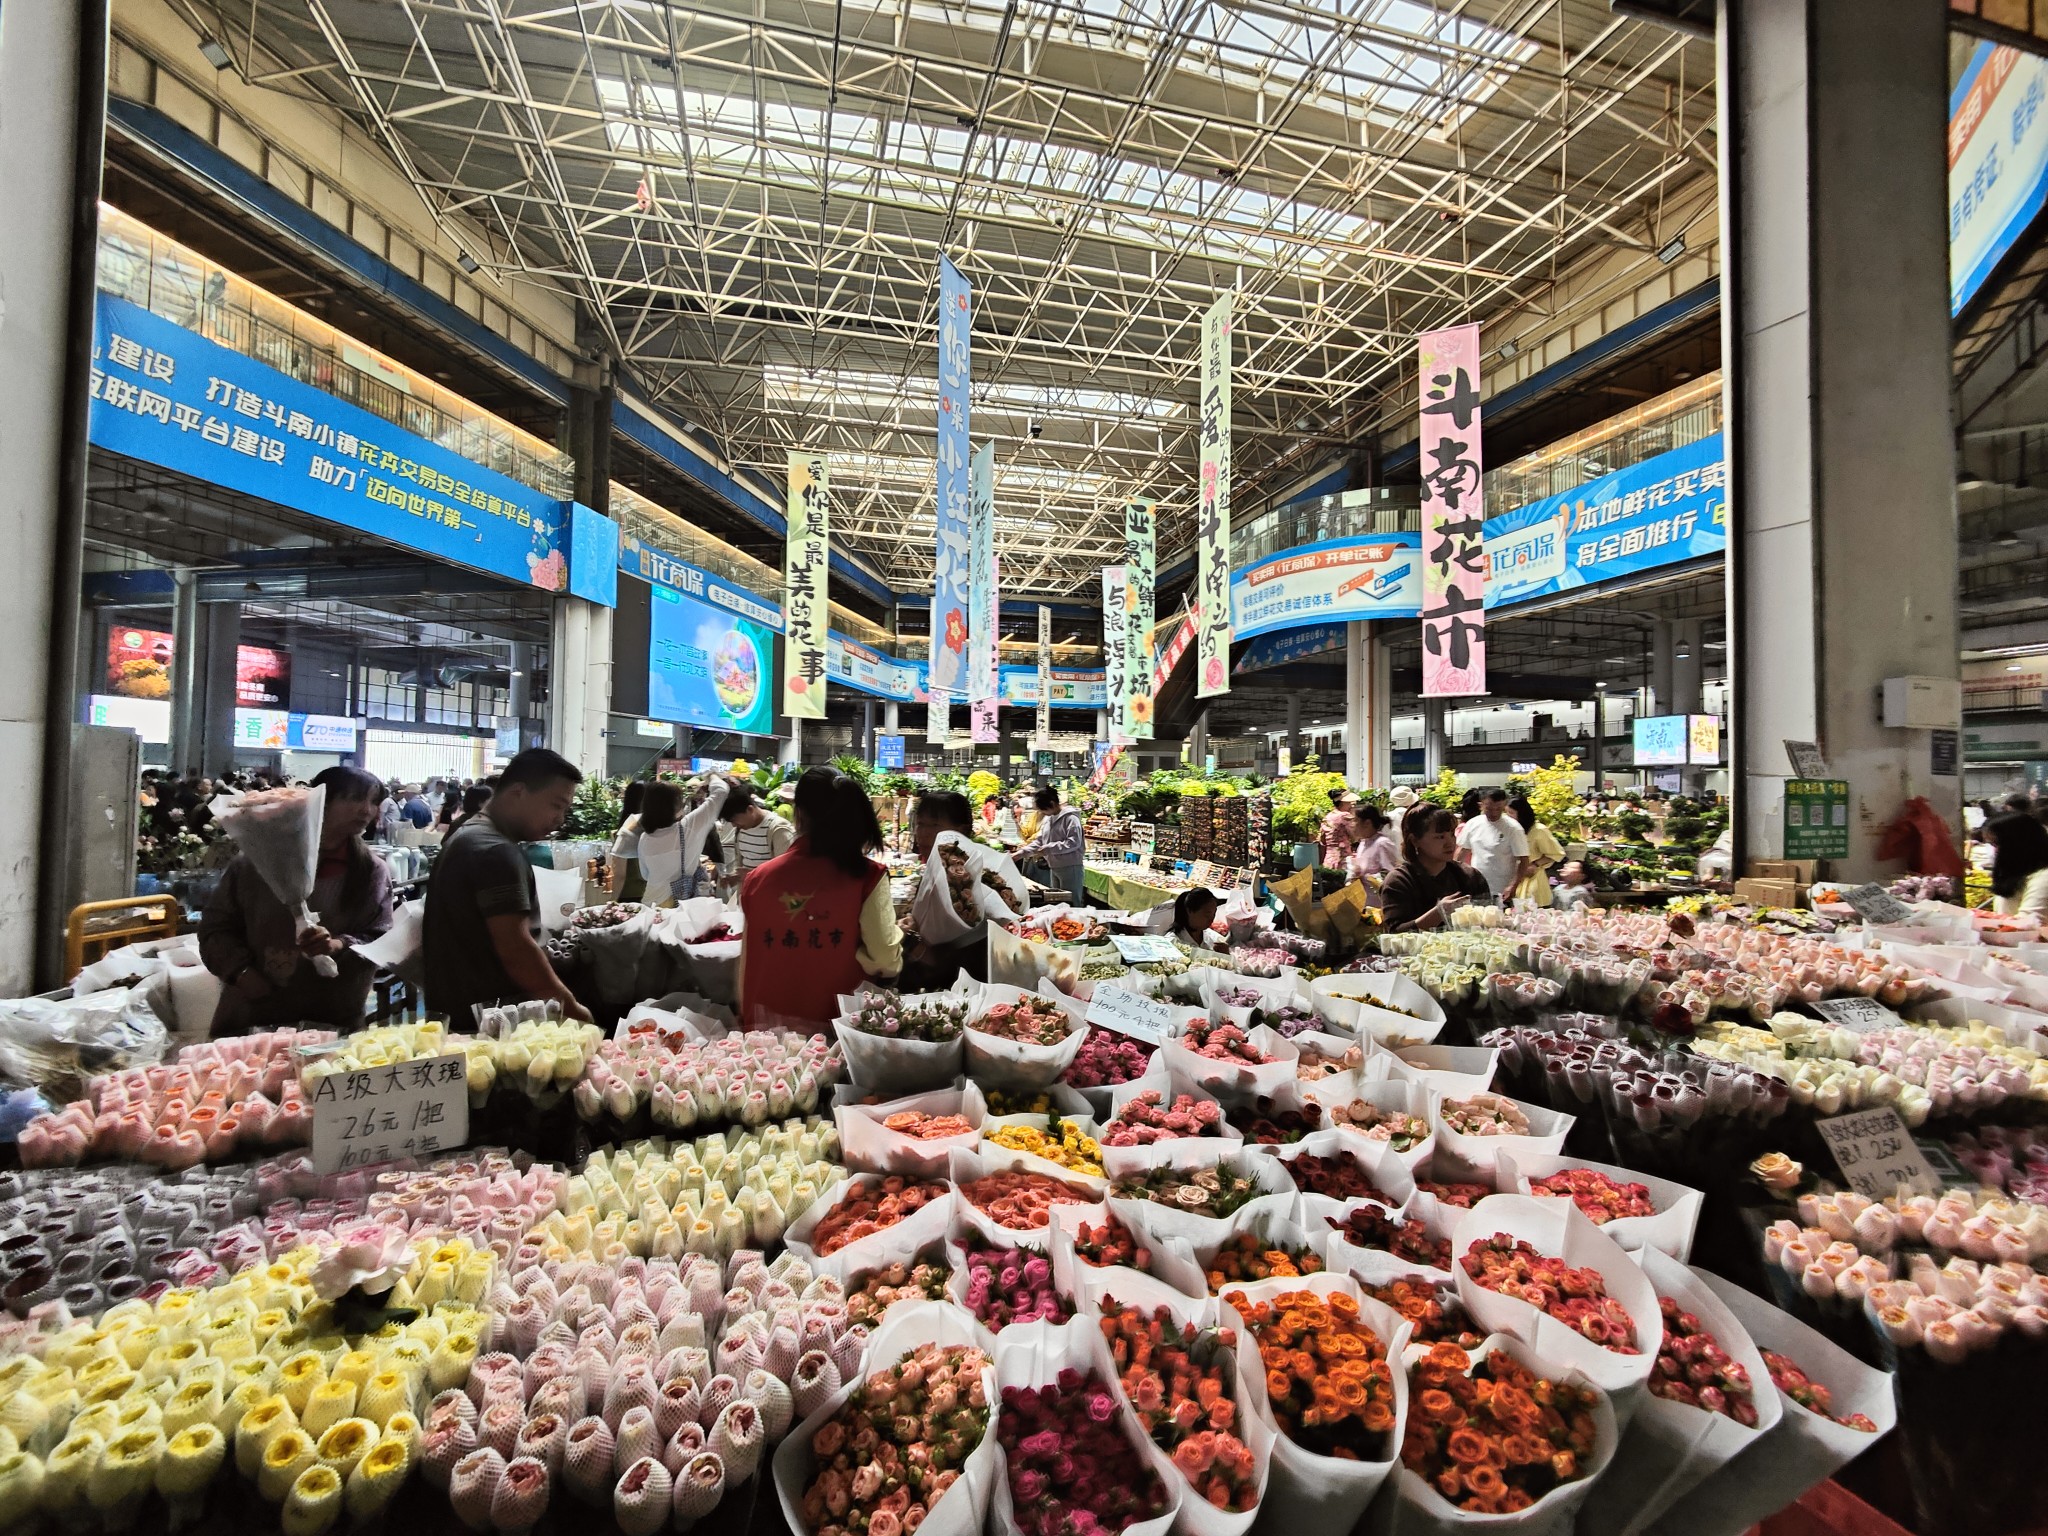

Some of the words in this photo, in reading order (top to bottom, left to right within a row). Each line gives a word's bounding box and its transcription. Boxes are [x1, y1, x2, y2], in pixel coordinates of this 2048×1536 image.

[205, 376, 532, 528] 打造斗南小镇花卉交易安全结算平台
[1199, 316, 1231, 660] 与你最爱的人共赴斗南之约
[1576, 461, 1726, 533] 本地鲜花买卖
[1420, 367, 1484, 669] 斗南花市
[651, 552, 704, 597] 花商保
[1493, 533, 1554, 571] 花商保
[304, 724, 328, 735] ZTO
[315, 1061, 463, 1103] A级大玫瑰
